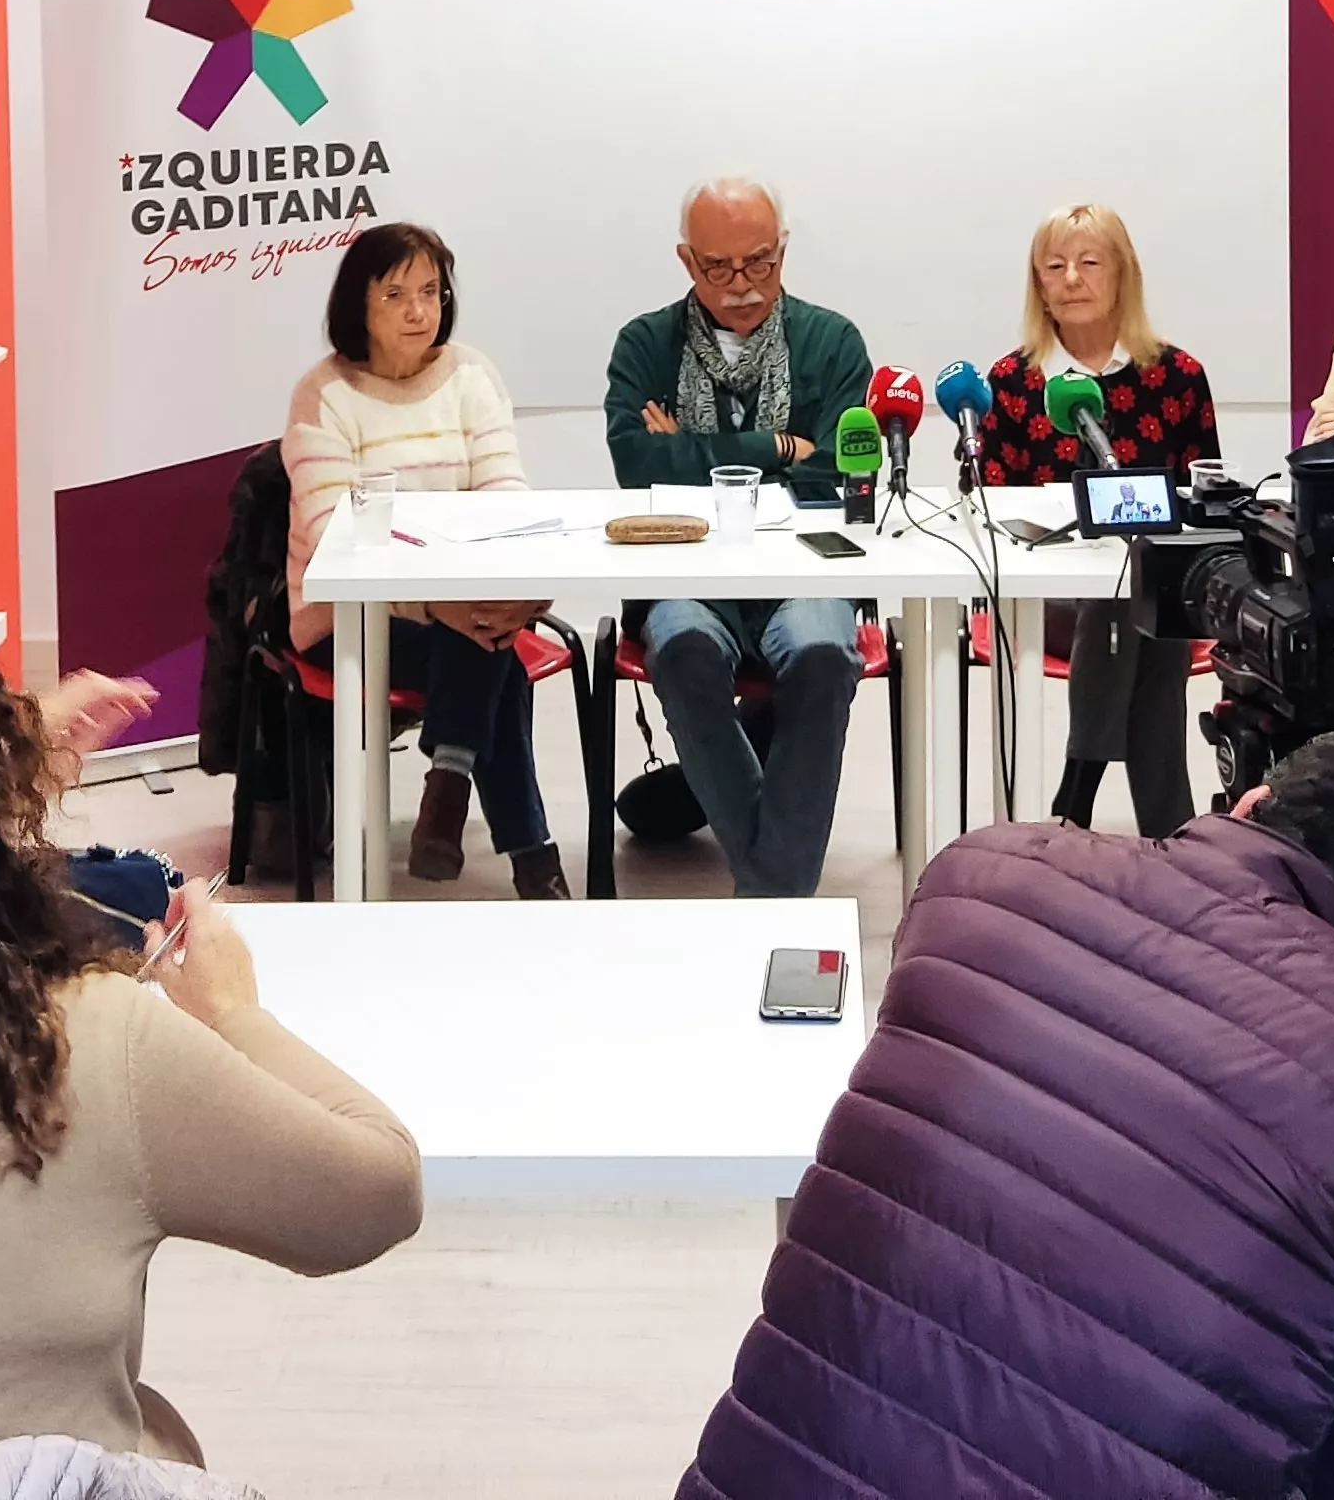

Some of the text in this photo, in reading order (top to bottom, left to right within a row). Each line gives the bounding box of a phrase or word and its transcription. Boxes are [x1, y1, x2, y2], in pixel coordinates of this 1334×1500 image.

[131, 184, 378, 236] GADITANA
[142, 230, 237, 291] Somos
[888, 366, 916, 389] 7
